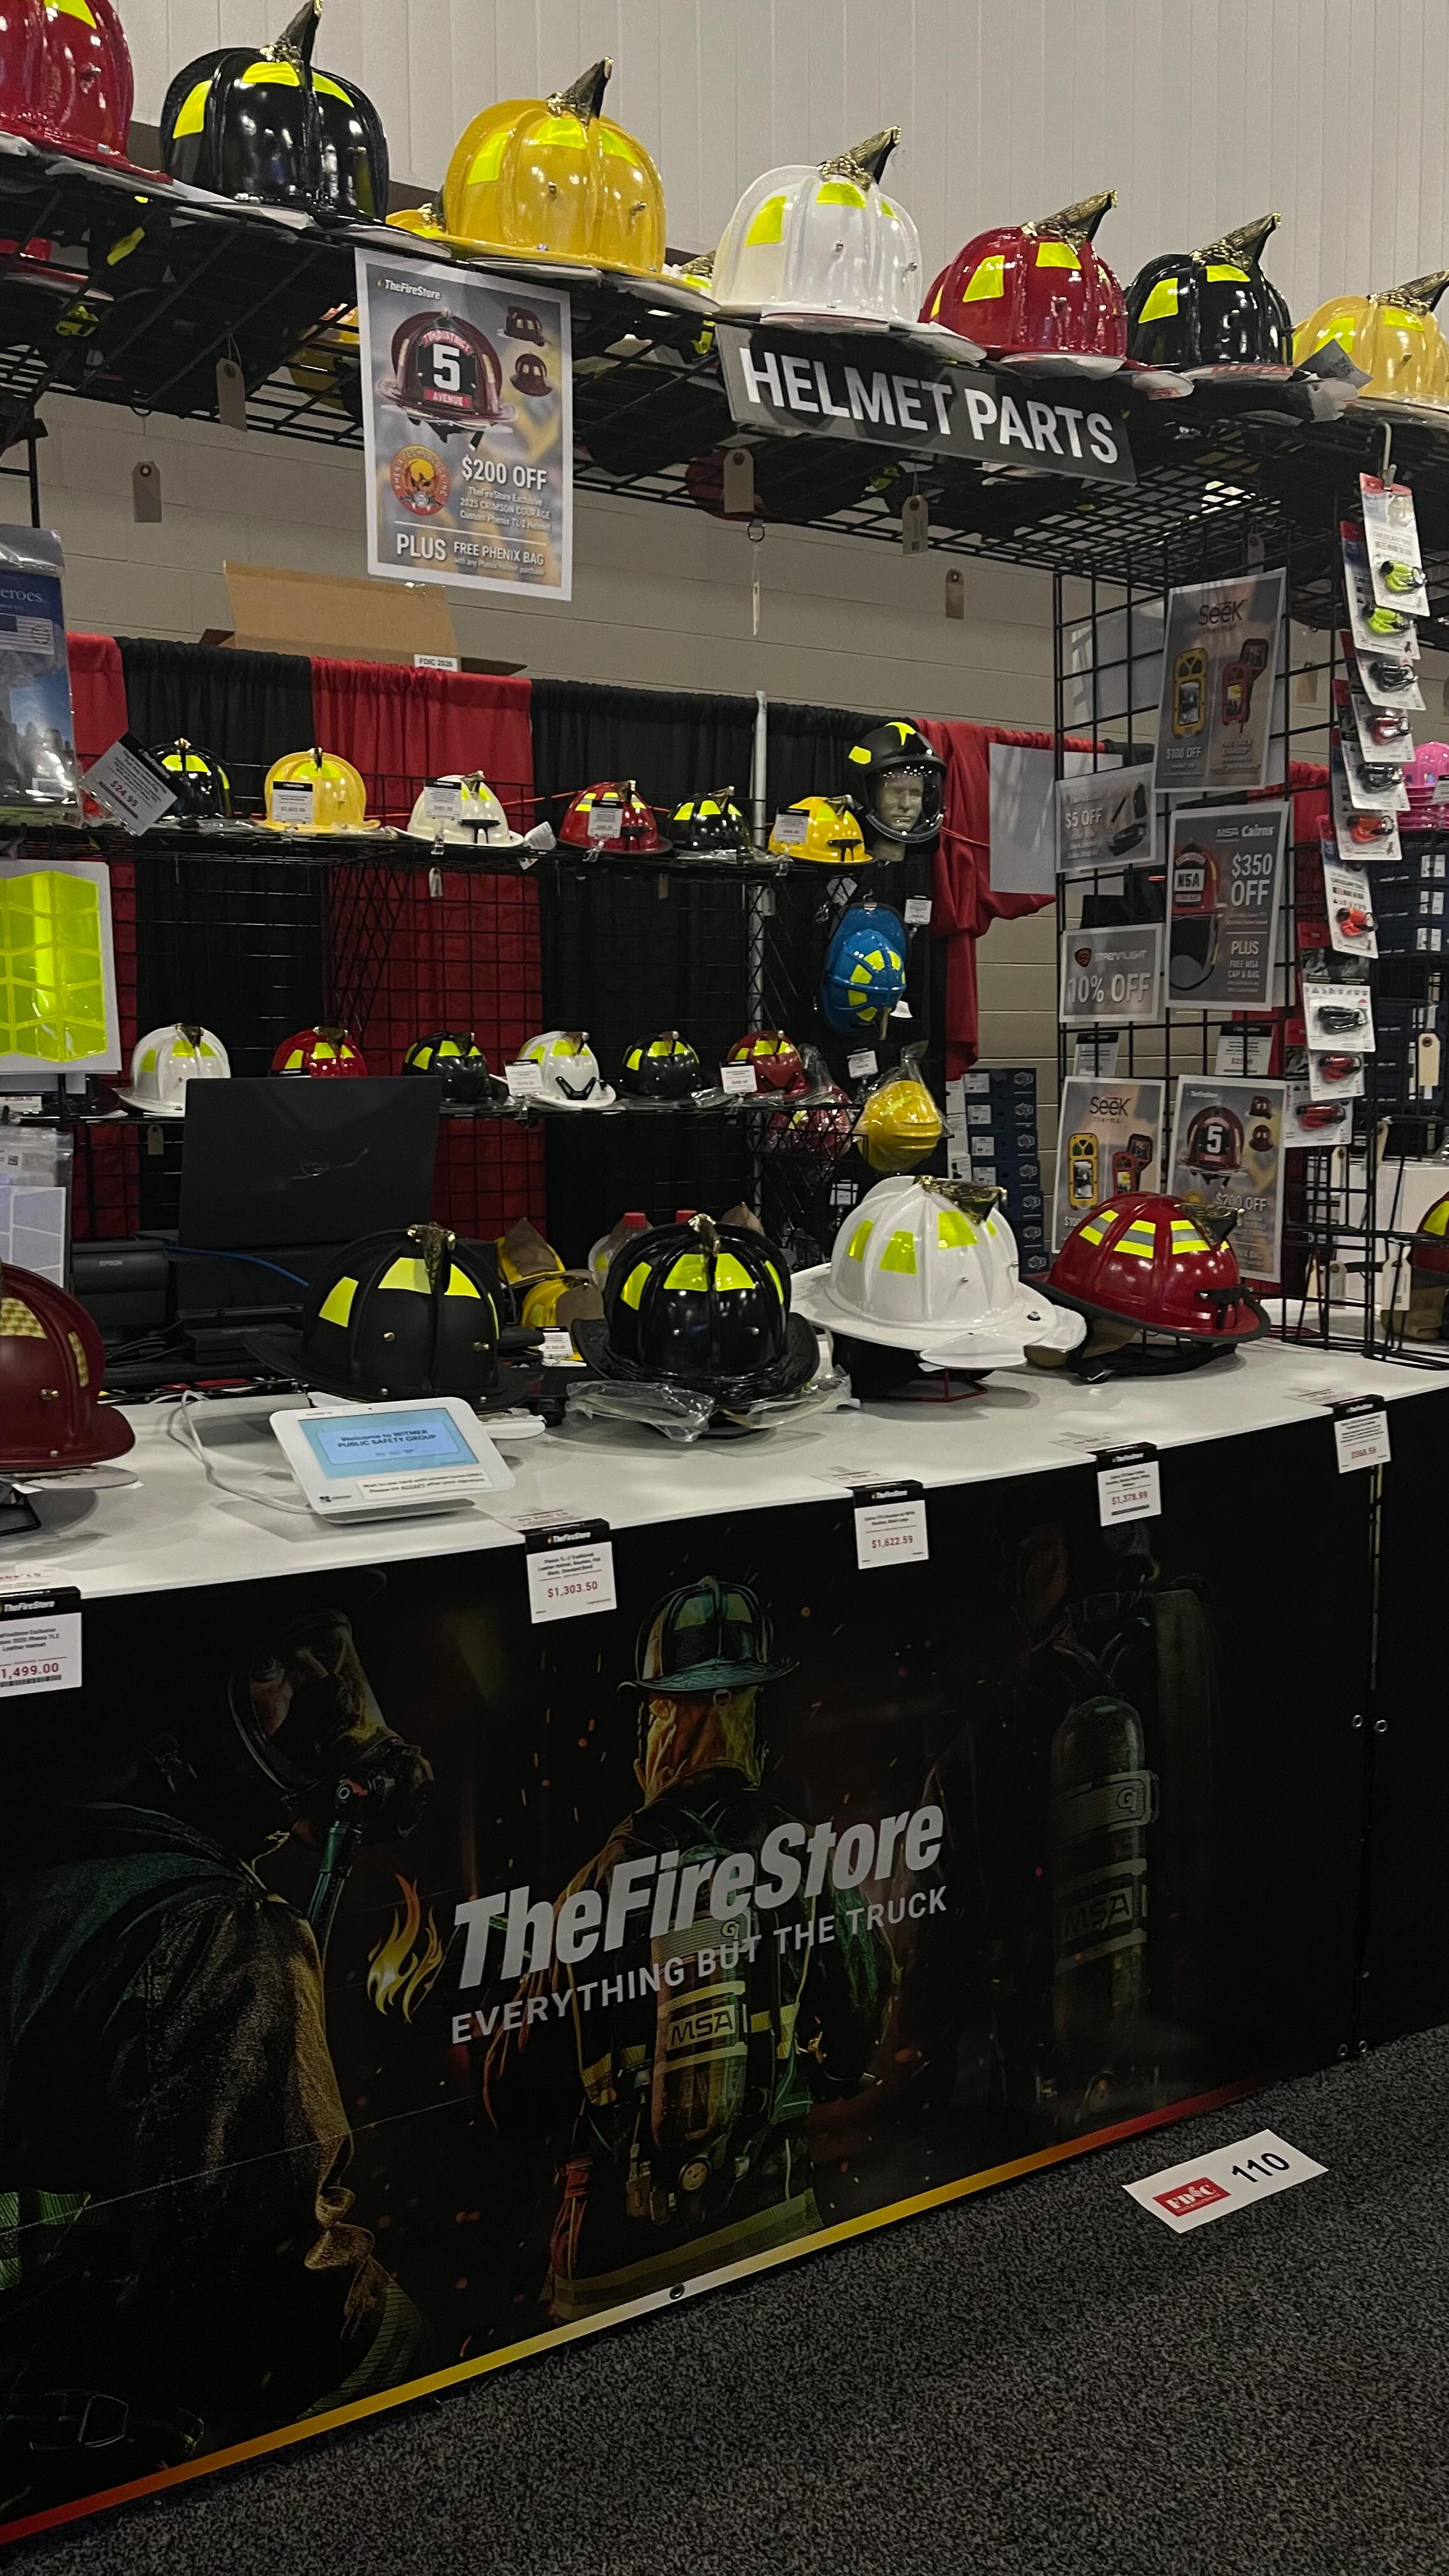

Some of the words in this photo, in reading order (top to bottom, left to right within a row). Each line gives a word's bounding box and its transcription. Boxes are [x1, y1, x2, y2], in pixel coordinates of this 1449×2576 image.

[385, 279, 441, 300] TheFireStore
[433, 343, 461, 392] 5
[432, 391, 464, 406] AVENUE
[739, 348, 953, 435] HELMET
[964, 388, 1119, 464] PARTS
[461, 454, 507, 485] $200
[513, 465, 547, 490] OFF
[396, 533, 447, 561] PLUS
[454, 540, 480, 556] FREE
[482, 545, 521, 562] PHENIX
[523, 551, 545, 566] BAG
[1186, 746, 1202, 759] OFF
[110, 780, 139, 807] $24.95
[1065, 811, 1078, 829] $5
[1081, 808, 1103, 825] OFF
[1241, 825, 1274, 838] Cairns
[1231, 852, 1273, 878] $350
[1231, 880, 1271, 907] OFF
[1230, 940, 1260, 955] PLUS
[1068, 974, 1105, 1004] 10%
[1111, 972, 1151, 1002] OFF
[1207, 1124, 1223, 1154] 5
[1245, 1196, 1267, 1212] OFF
[337, 1439, 371, 1448] PUBLIC
[394, 1429, 428, 1438] WITMER
[871, 1535, 914, 1549] $1,622.59
[547, 1581, 598, 1598] $1,303.50
[1, 1662, 59, 1680] 1,499.00
[453, 1804, 944, 1991] TheFireStore
[452, 1956, 686, 2044] EVERYTHING
[698, 1935, 762, 1979] BUT
[772, 1914, 836, 1954] THE
[847, 1885, 947, 1935] TRUCK
[671, 2010, 733, 2047] MSA
[1230, 2152, 1291, 2183] 110
[1165, 2184, 1217, 2209] FDIC
